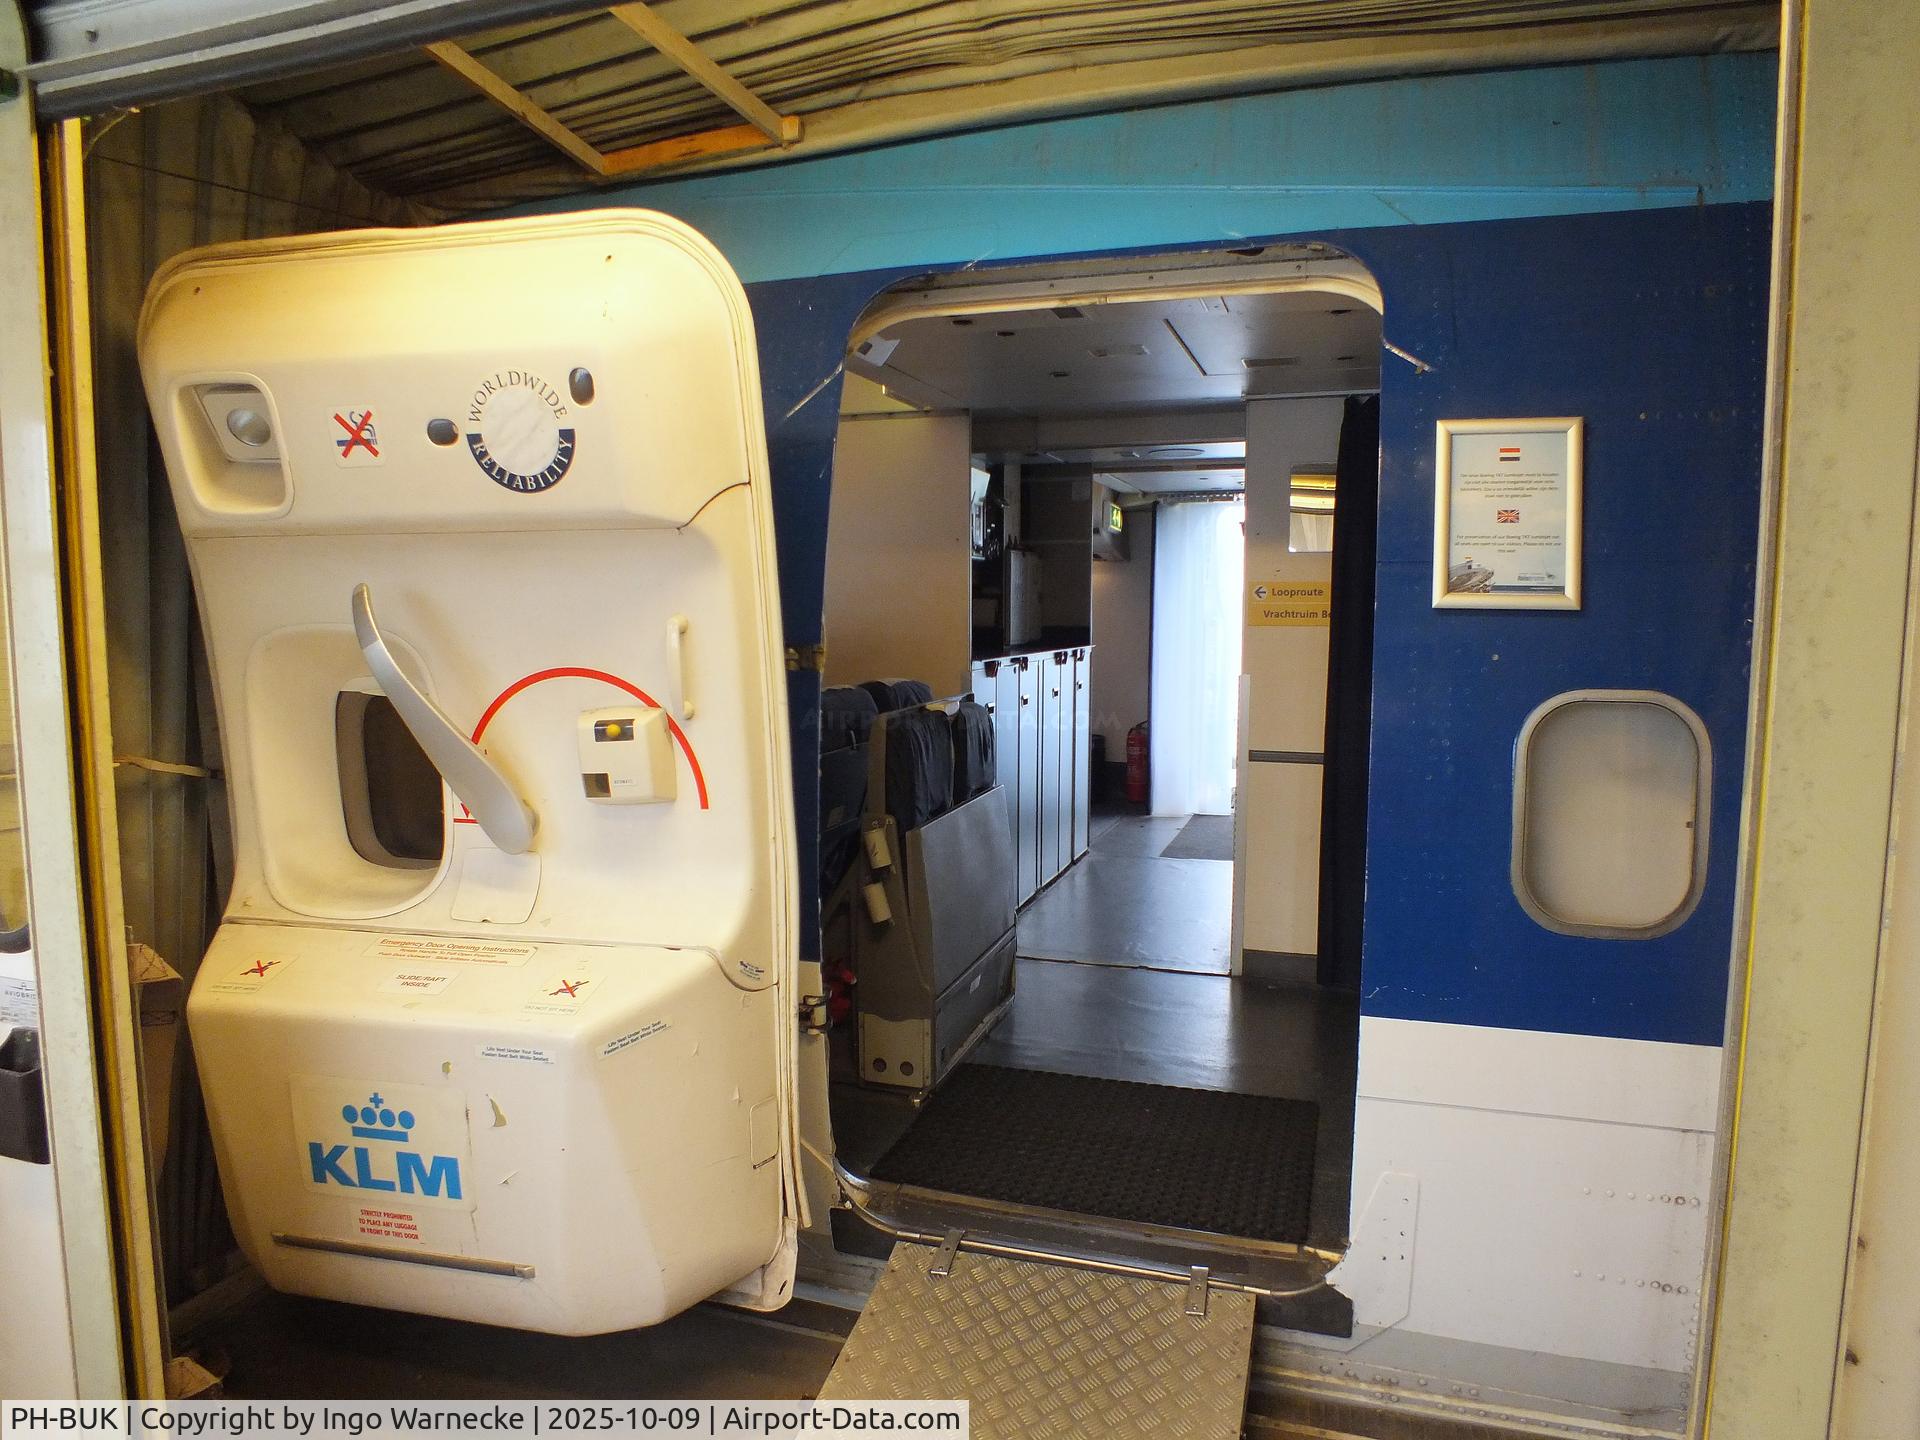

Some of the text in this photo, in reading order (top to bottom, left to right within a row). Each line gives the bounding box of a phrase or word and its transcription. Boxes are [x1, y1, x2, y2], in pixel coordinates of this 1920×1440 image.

[468, 370, 568, 423] WORLDWIDE
[473, 437, 573, 490] RELIABILITY
[1271, 588, 1324, 598] Looproute
[1263, 609, 1318, 619] Vrachtruim
[380, 938, 530, 954] Emergency Door Opening Instructions
[395, 974, 448, 983] SLIDE/RAFT
[309, 1142, 462, 1200] KLM
[361, 1209, 413, 1221] STRICTLY PROHIBITED
[366, 1218, 381, 1226] PLACE
[394, 1223, 417, 1231] LUGGAGE
